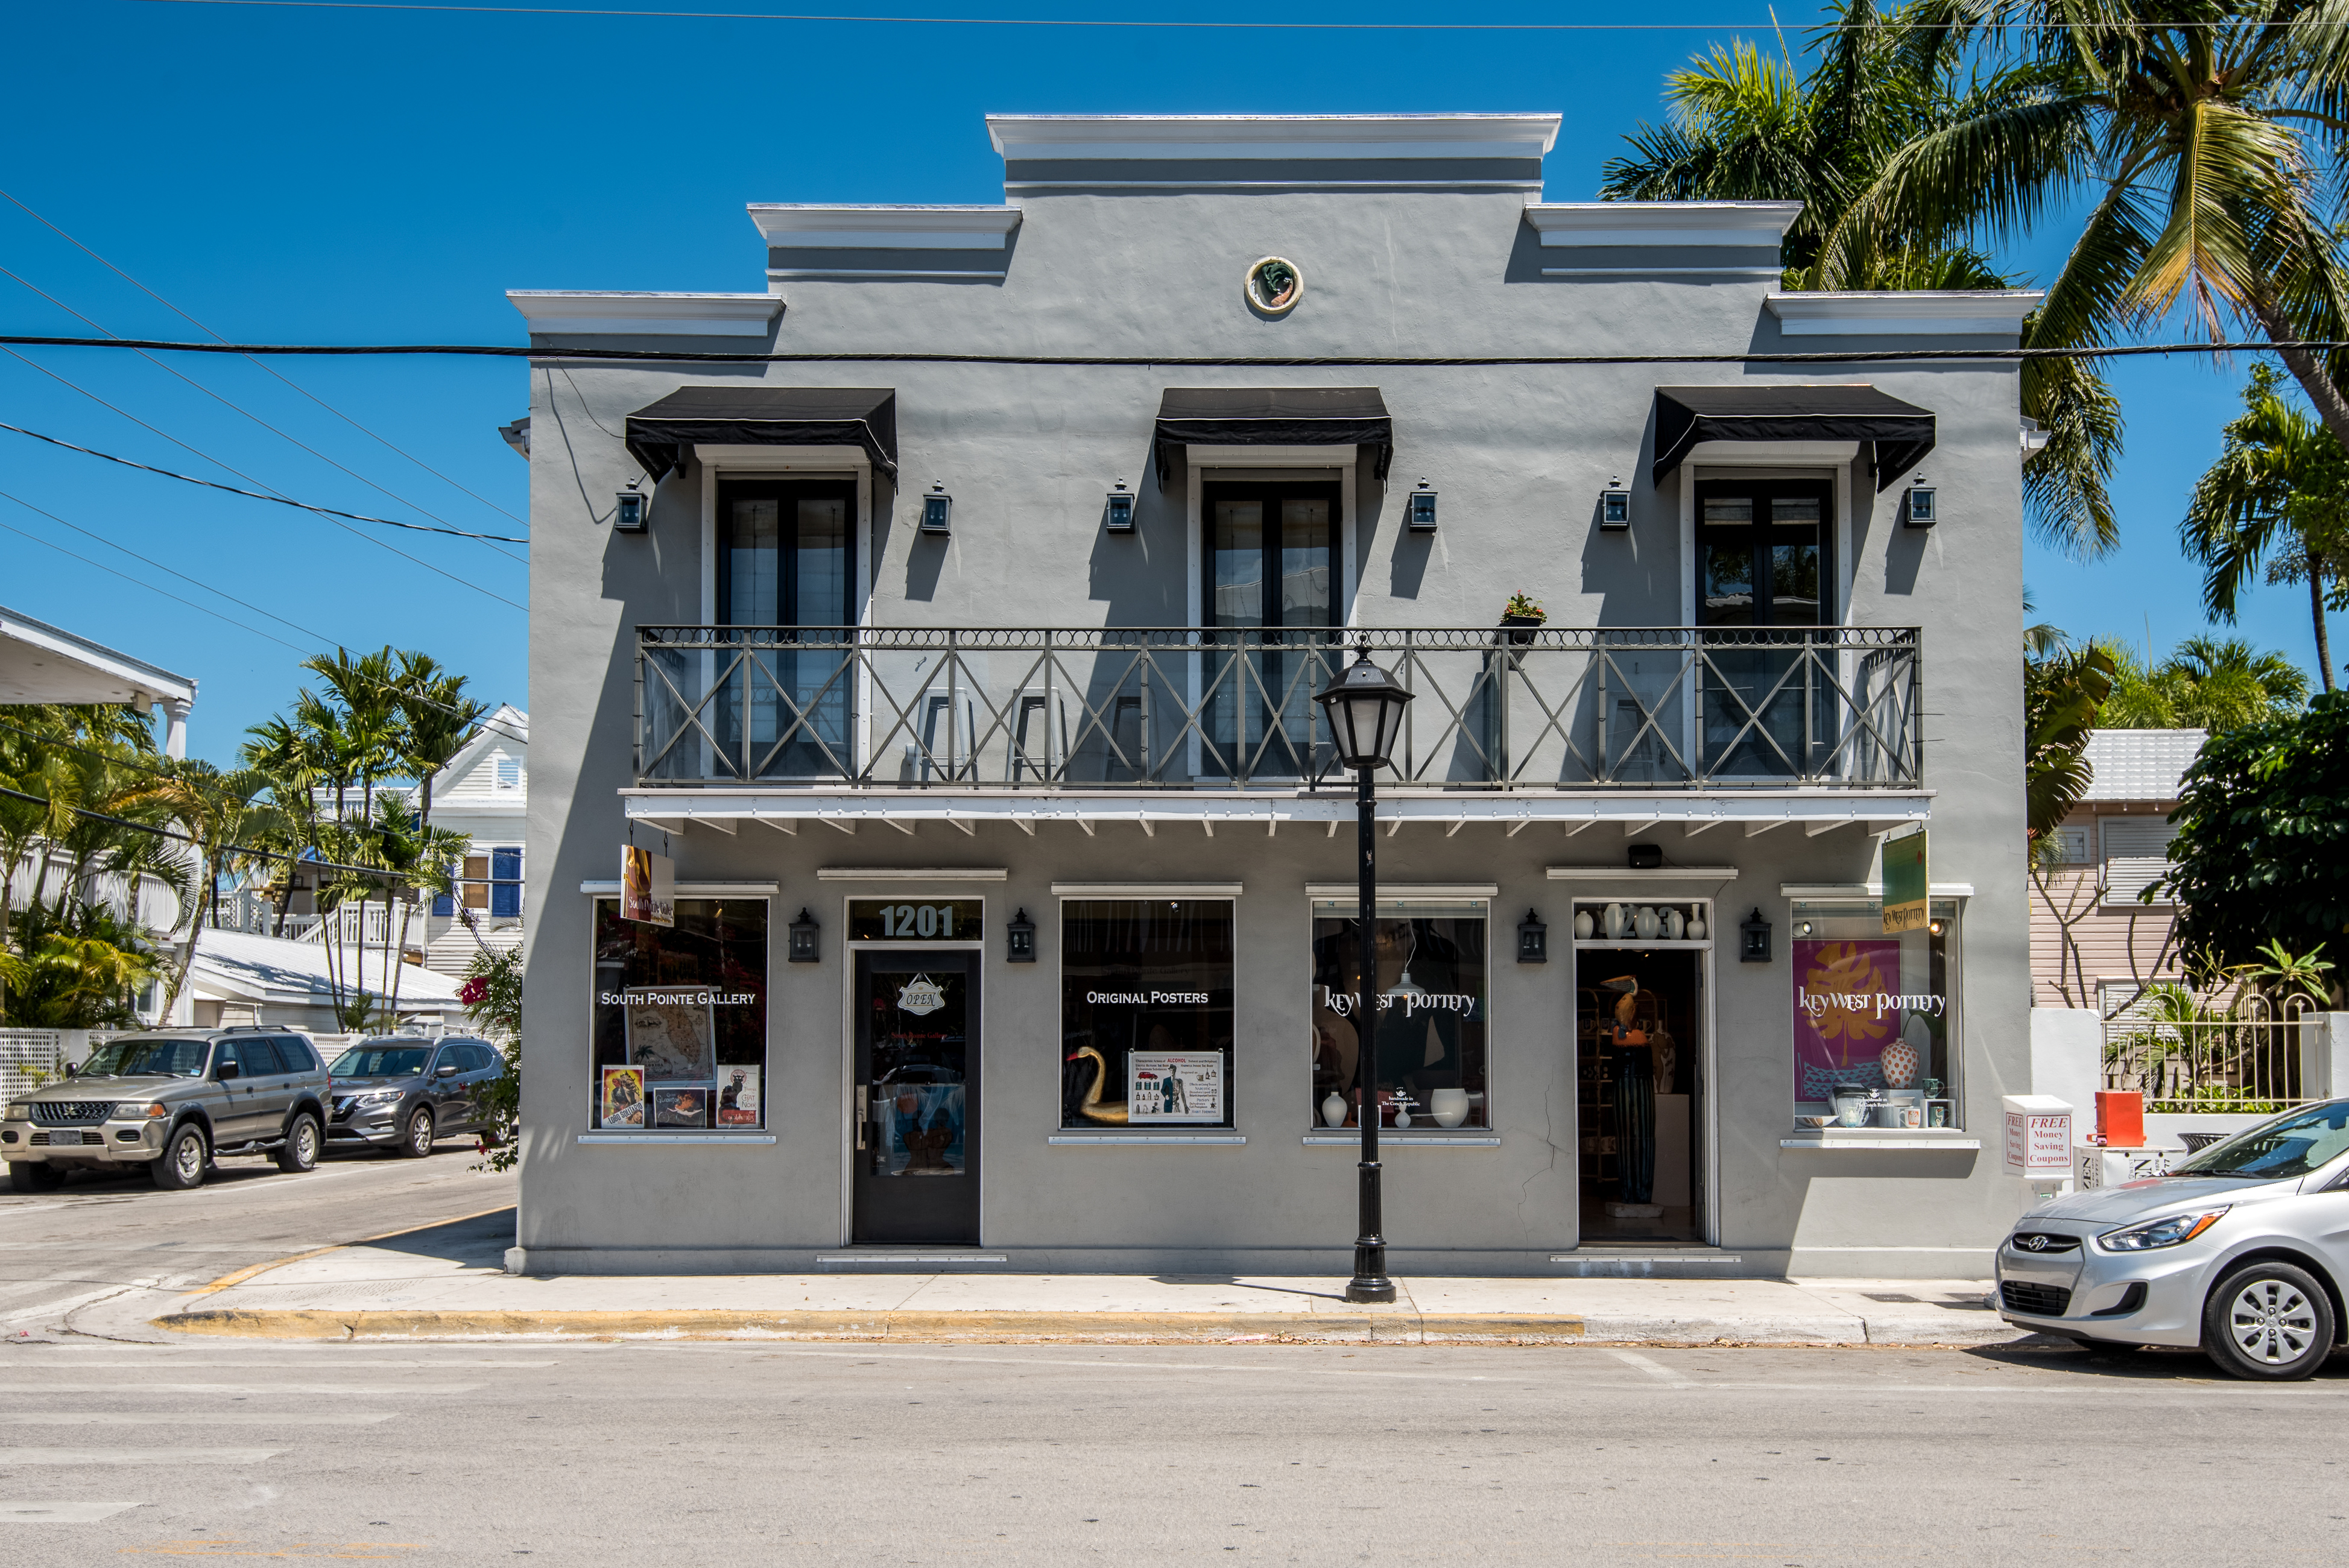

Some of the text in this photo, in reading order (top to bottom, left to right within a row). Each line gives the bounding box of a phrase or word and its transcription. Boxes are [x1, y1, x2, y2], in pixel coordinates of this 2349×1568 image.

[628, 896, 643, 911] South
[644, 899, 659, 913] Pointe
[879, 905, 952, 936] 1201
[906, 993, 936, 1007] OPEN
[741, 1094, 756, 1102] CHAT
[608, 1102, 643, 1125] LOBO SOLITARIO
[2007, 1115, 2022, 1127] FREE
[2030, 1118, 2068, 1128] FREE
[2009, 1128, 2021, 1139] Money
[2034, 1130, 2064, 1140] Money
[2009, 1140, 2021, 1151] Saving
[2034, 1142, 2064, 1152] Saving
[2008, 1151, 2023, 1162] Coupons
[2029, 1154, 2068, 1164] Coupons
